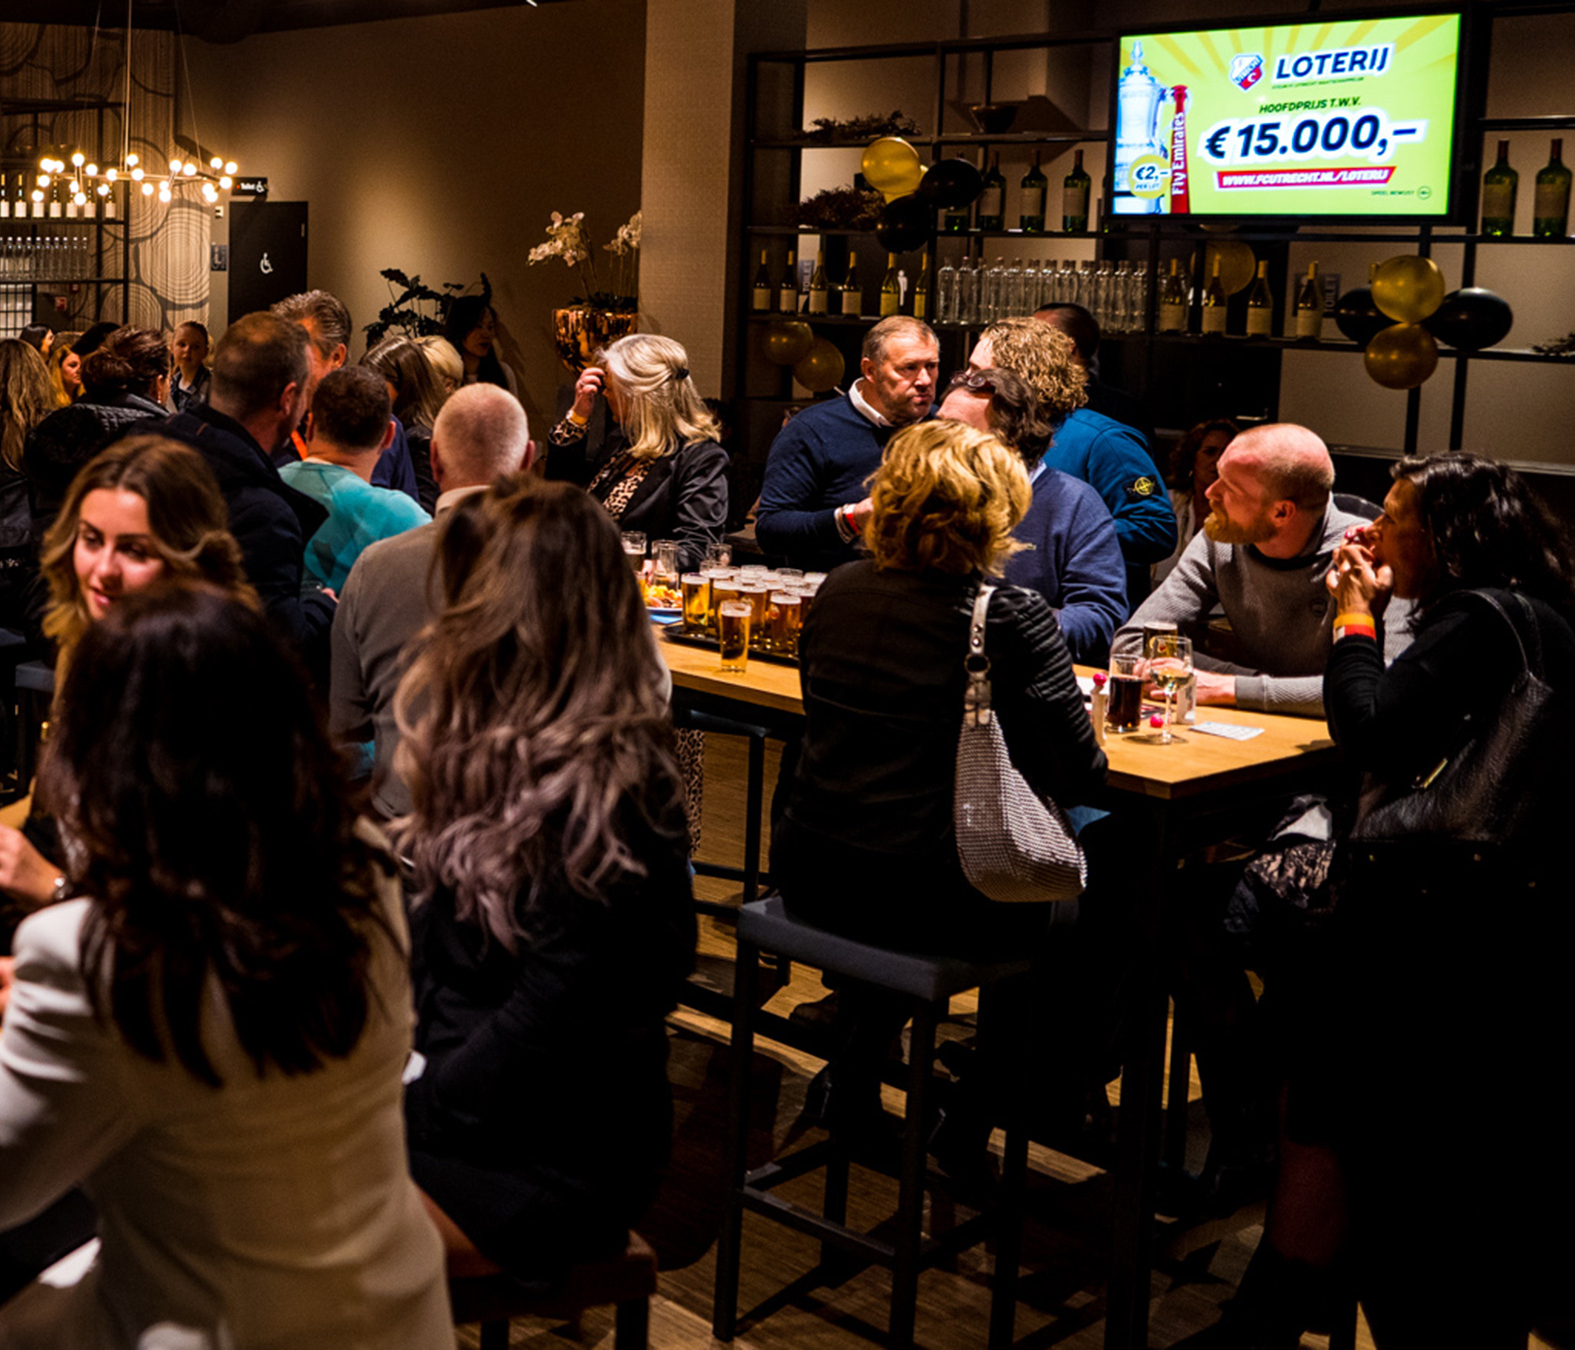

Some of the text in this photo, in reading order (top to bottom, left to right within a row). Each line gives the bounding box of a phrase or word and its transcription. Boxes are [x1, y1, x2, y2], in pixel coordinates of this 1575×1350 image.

[1276, 47, 1390, 79] LOTERIJ
[1259, 99, 1328, 114] HOOFDPRIJS
[1205, 126, 1232, 159] €
